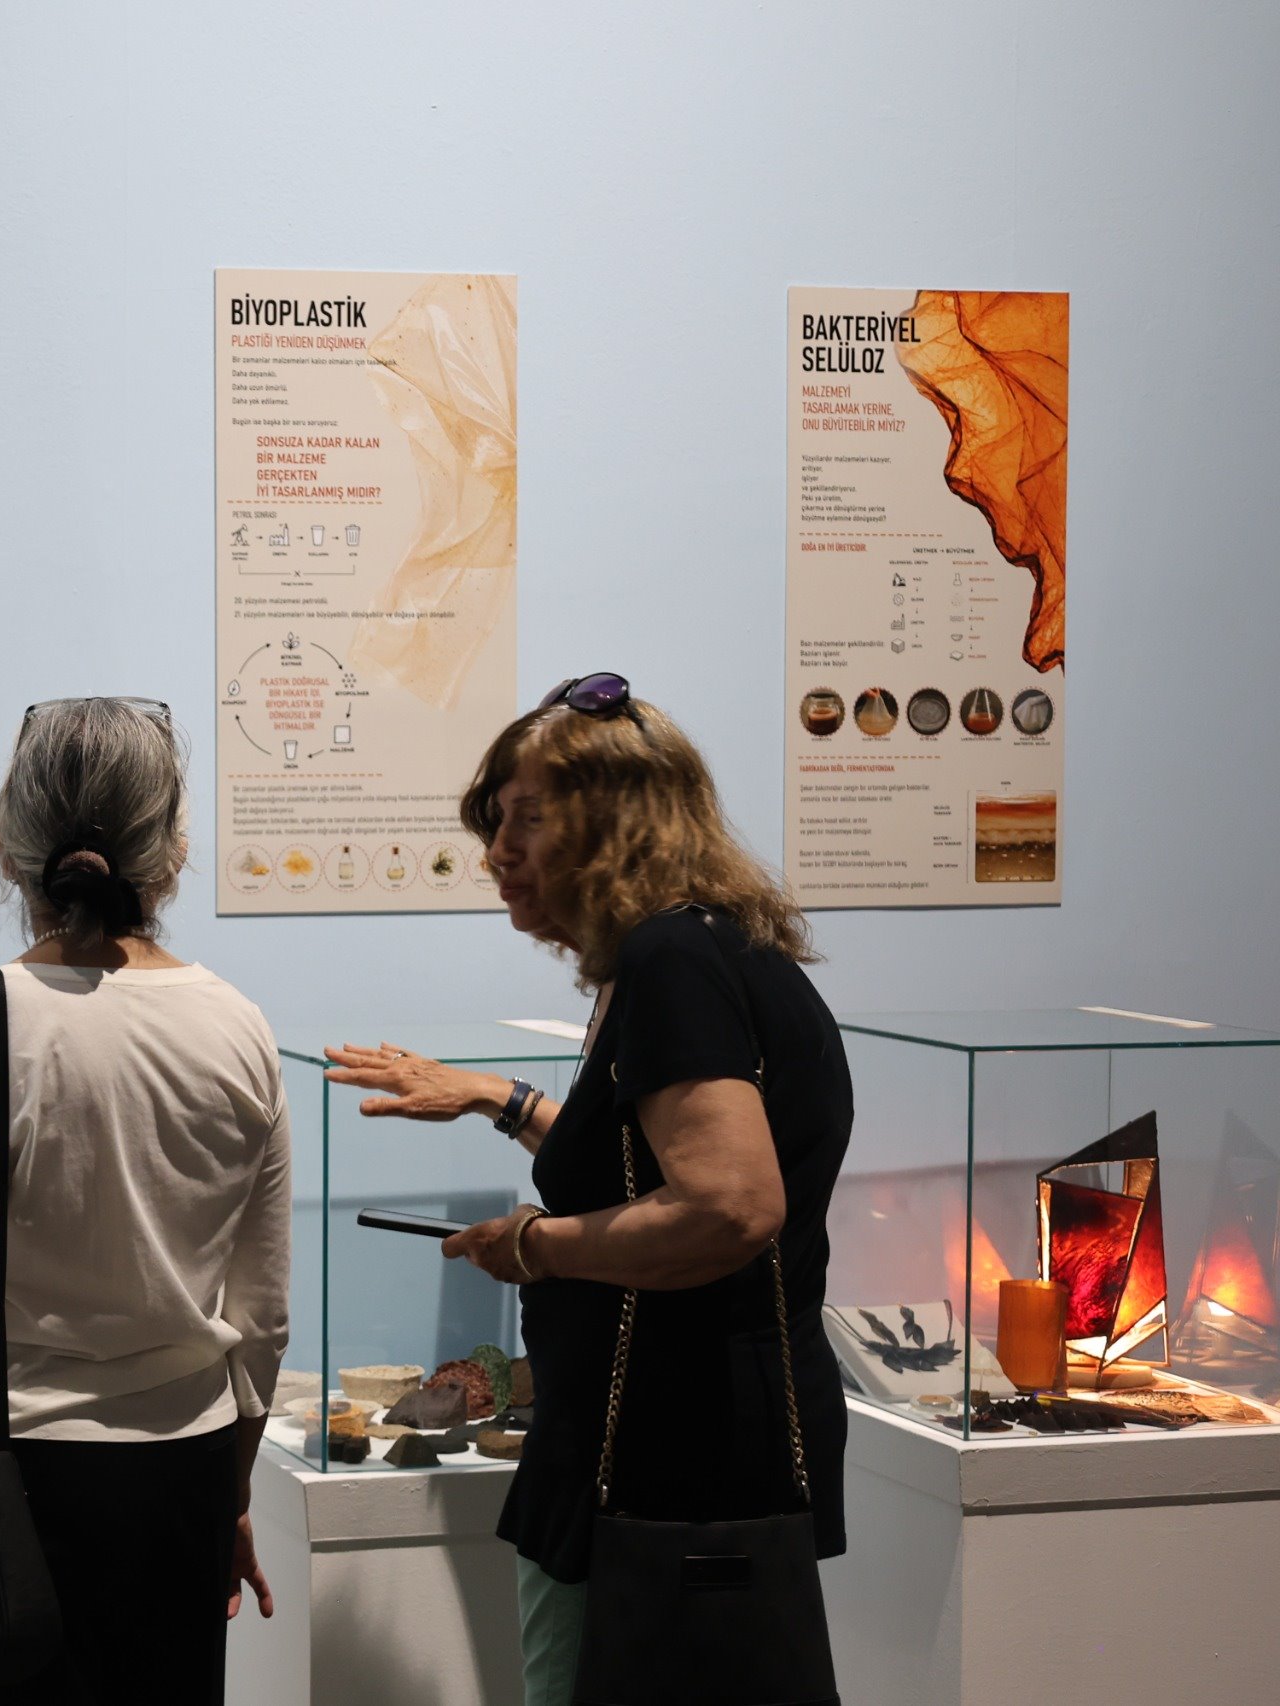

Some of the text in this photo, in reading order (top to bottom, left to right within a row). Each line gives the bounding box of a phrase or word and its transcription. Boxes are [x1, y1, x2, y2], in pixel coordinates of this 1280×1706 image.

[231, 293, 366, 328] BİYOPLASTİK
[803, 311, 921, 342] BAKTERİYEL
[232, 332, 366, 351] PLASTİĞİ YENİDEN DÜŞÜNMEK
[803, 342, 884, 373] SELÜLOZ
[802, 384, 851, 398] MALZEMEYİ
[802, 402, 894, 416] TASARLAMAK YERİNE,
[802, 417, 905, 432] ONU BÜYÜTEBİLİR MİYİZ?
[257, 436, 380, 448] SONSUZA KADAR KALAN
[257, 452, 326, 464] BİR MALZEME
[257, 470, 317, 483] GERÇEKTEN
[257, 485, 380, 500] İYİ TASARLANMIŞ MIDIR?
